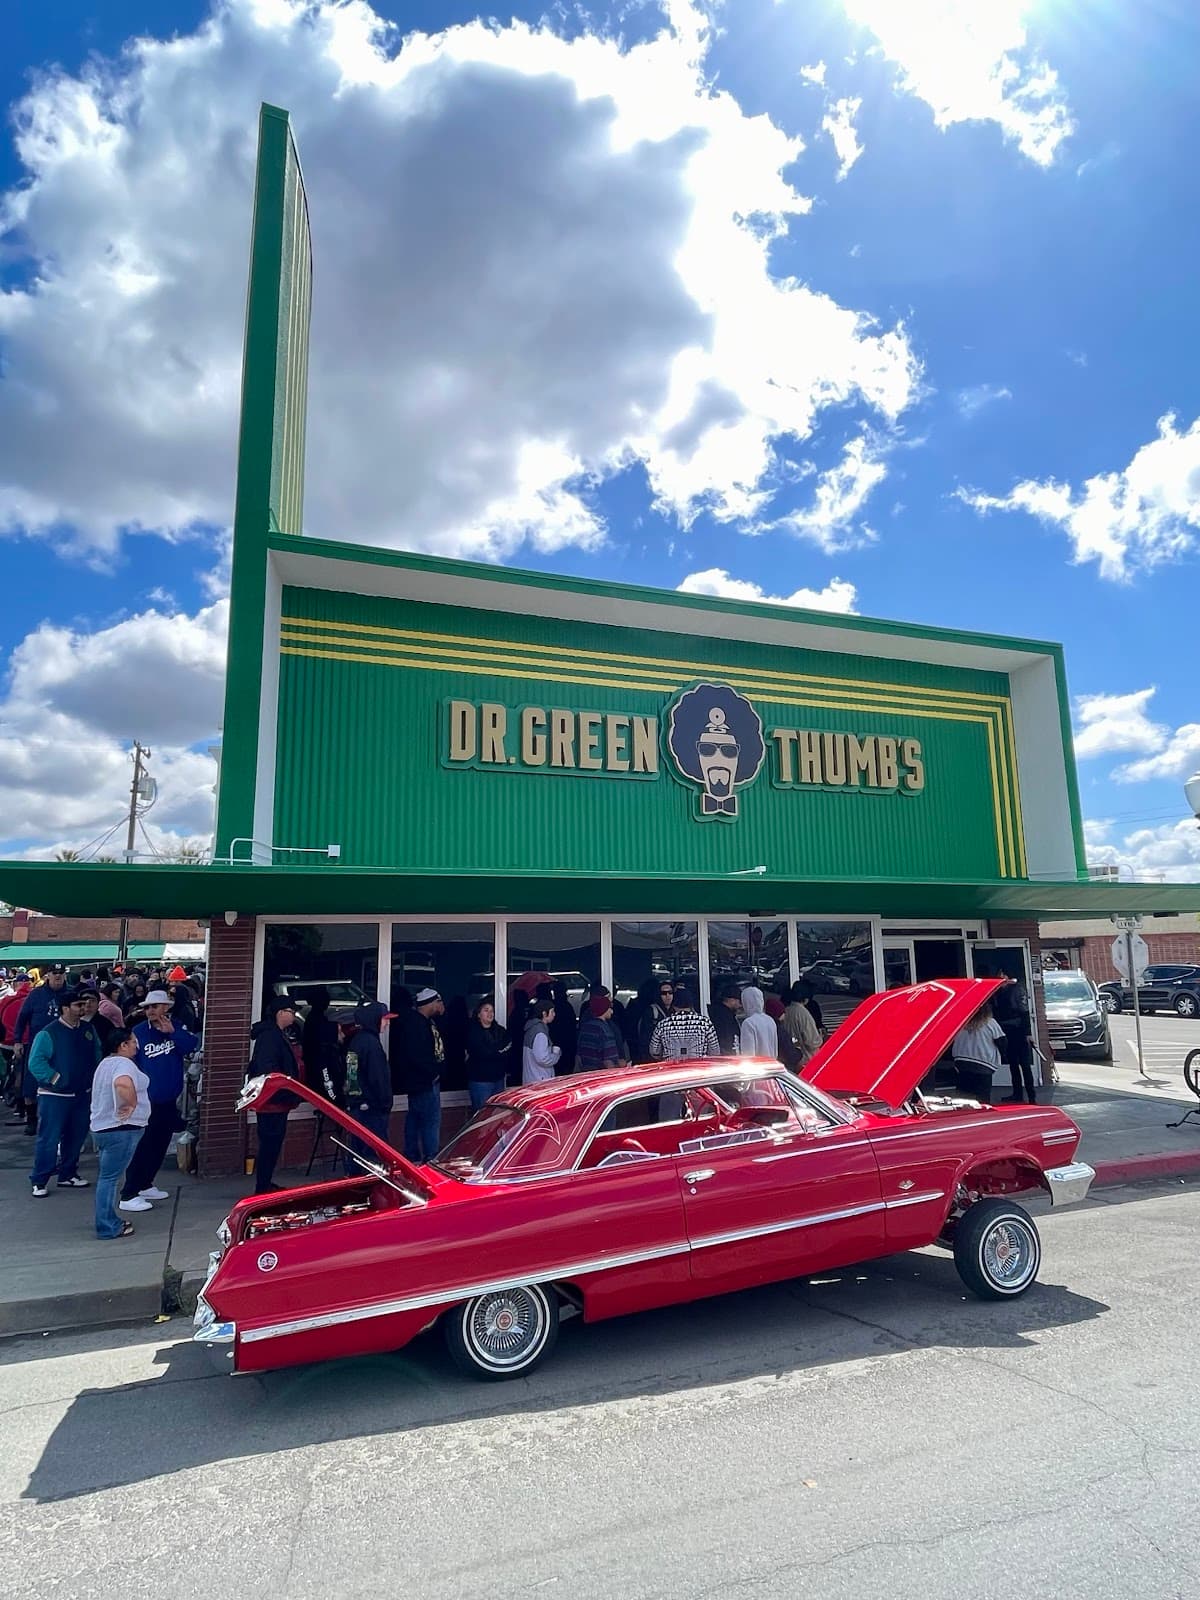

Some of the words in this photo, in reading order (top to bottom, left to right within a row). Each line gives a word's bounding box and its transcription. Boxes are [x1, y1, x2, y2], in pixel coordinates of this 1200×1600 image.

[449, 699, 517, 765] DR.
[521, 706, 659, 774] GREEN
[772, 728, 925, 790] THUMB'S
